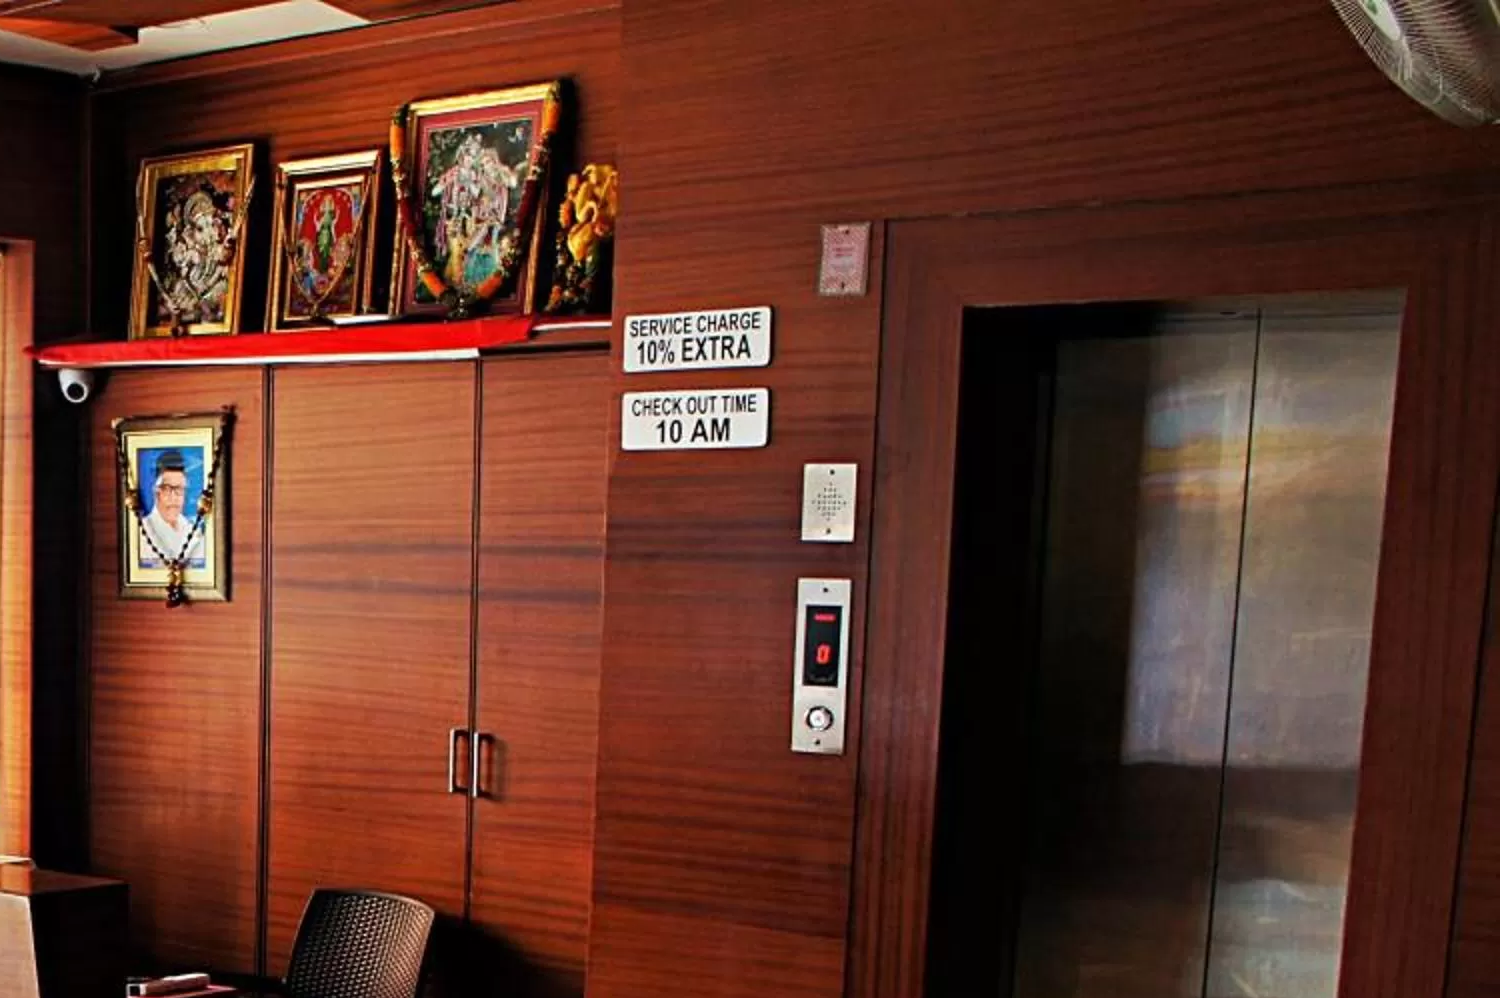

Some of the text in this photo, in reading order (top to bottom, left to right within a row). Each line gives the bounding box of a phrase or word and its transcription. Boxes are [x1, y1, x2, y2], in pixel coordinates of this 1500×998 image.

[629, 311, 761, 337] SERVICE CHARGE
[637, 334, 751, 364] 10% EXTRA
[631, 394, 757, 416] CHECK OUT TIME
[656, 417, 730, 443] 10 AM
